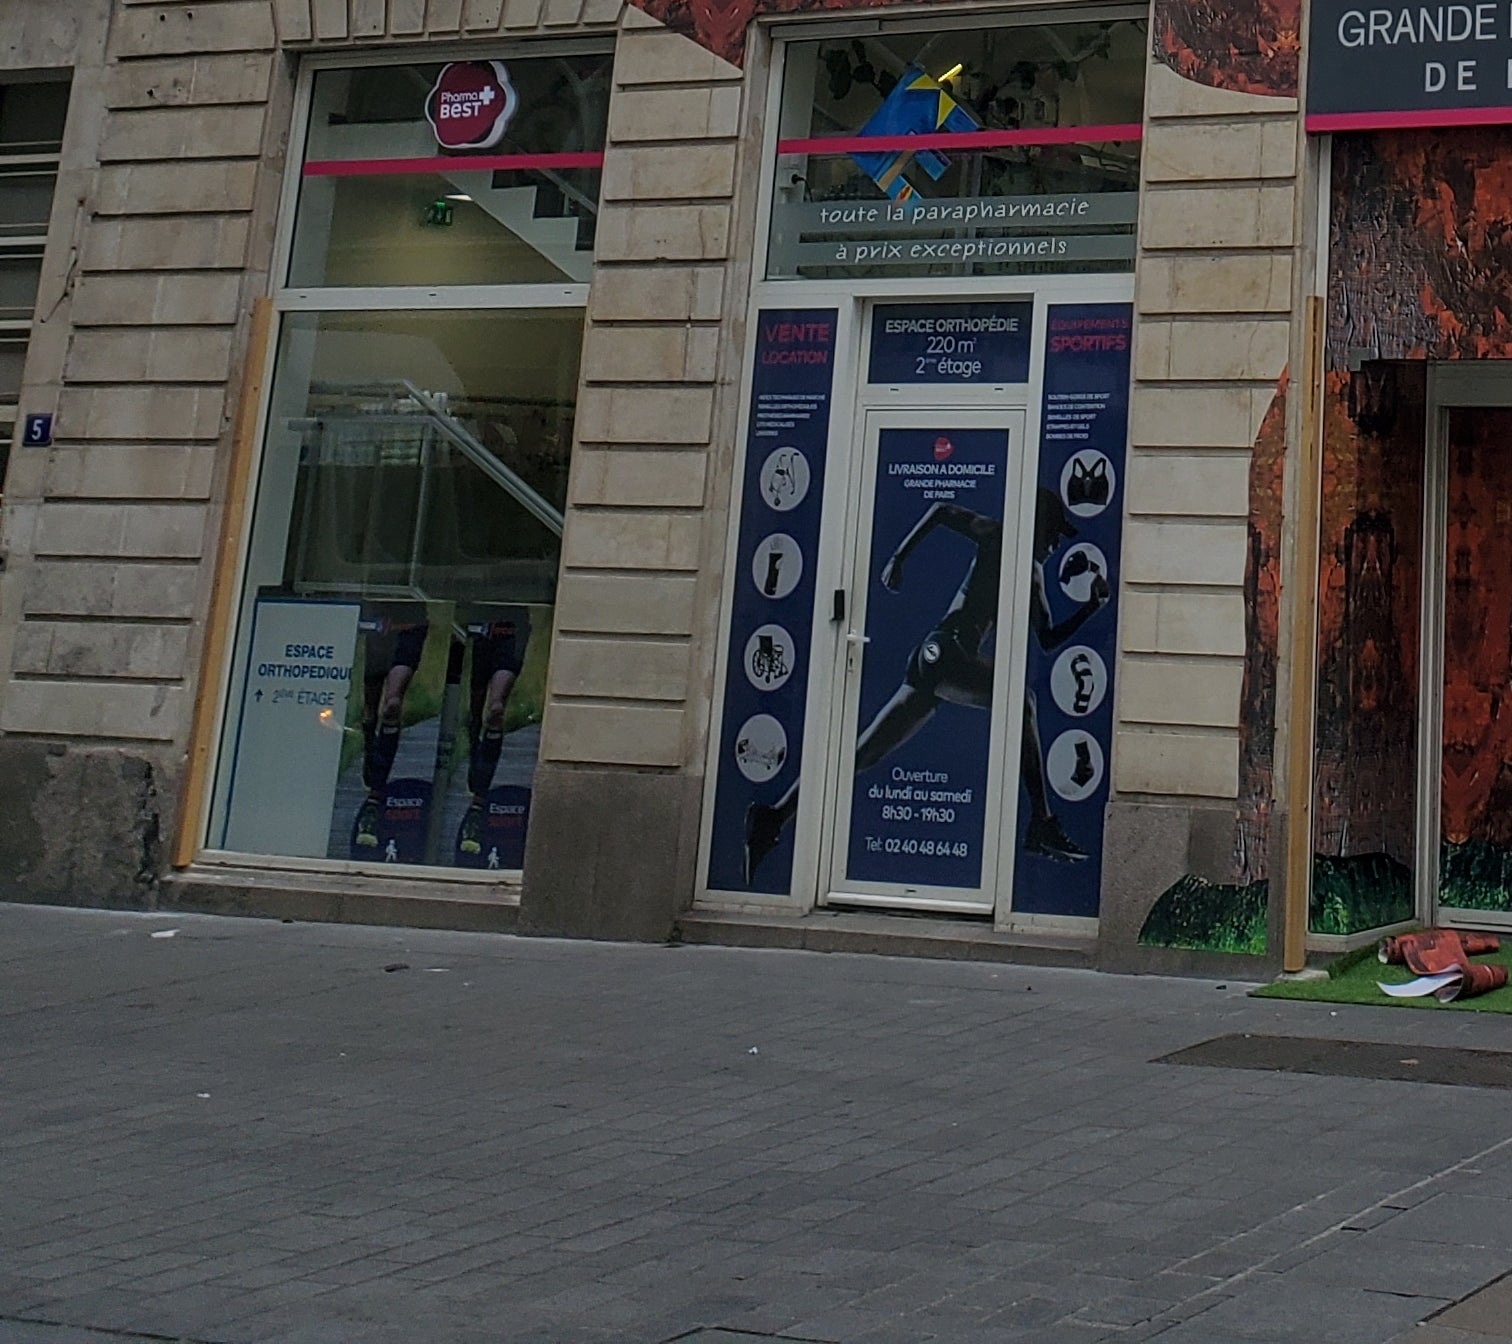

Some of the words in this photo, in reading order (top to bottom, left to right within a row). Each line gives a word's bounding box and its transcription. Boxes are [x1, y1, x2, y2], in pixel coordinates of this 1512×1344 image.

[1337, 3, 1498, 47] GRANDE
[1424, 59, 1478, 93] DE
[441, 92, 478, 103] Pharma
[820, 205, 879, 224] toute
[886, 204, 904, 222] la
[912, 197, 1090, 225] parapharmacie
[835, 243, 847, 260] à
[855, 241, 902, 263] prix
[910, 238, 1068, 261] exceptionnels
[765, 323, 829, 343] VENTE
[885, 319, 935, 333] ESPACE
[936, 315, 1019, 333] ORTHOPÉDIE
[926, 336, 955, 354] 220
[1050, 334, 1127, 352] SPORTIFS
[762, 350, 828, 365] LOCATION
[937, 357, 982, 378] étage
[31, 419, 43, 440] 5
[888, 463, 940, 475] LIVRAISON
[947, 463, 996, 475] DOMICILE
[285, 644, 334, 659] ESPACE
[891, 766, 948, 783] Ouverture
[868, 784, 883, 799] du
[885, 784, 913, 800] lundi
[913, 790, 928, 801] au
[930, 788, 973, 803] samedi
[882, 805, 912, 821] 8h30
[921, 807, 955, 823] 19h30
[885, 838, 901, 853] 02
[901, 839, 918, 854] 40
[919, 840, 935, 855] 48
[936, 841, 950, 856] 64
[952, 842, 968, 857] 48
